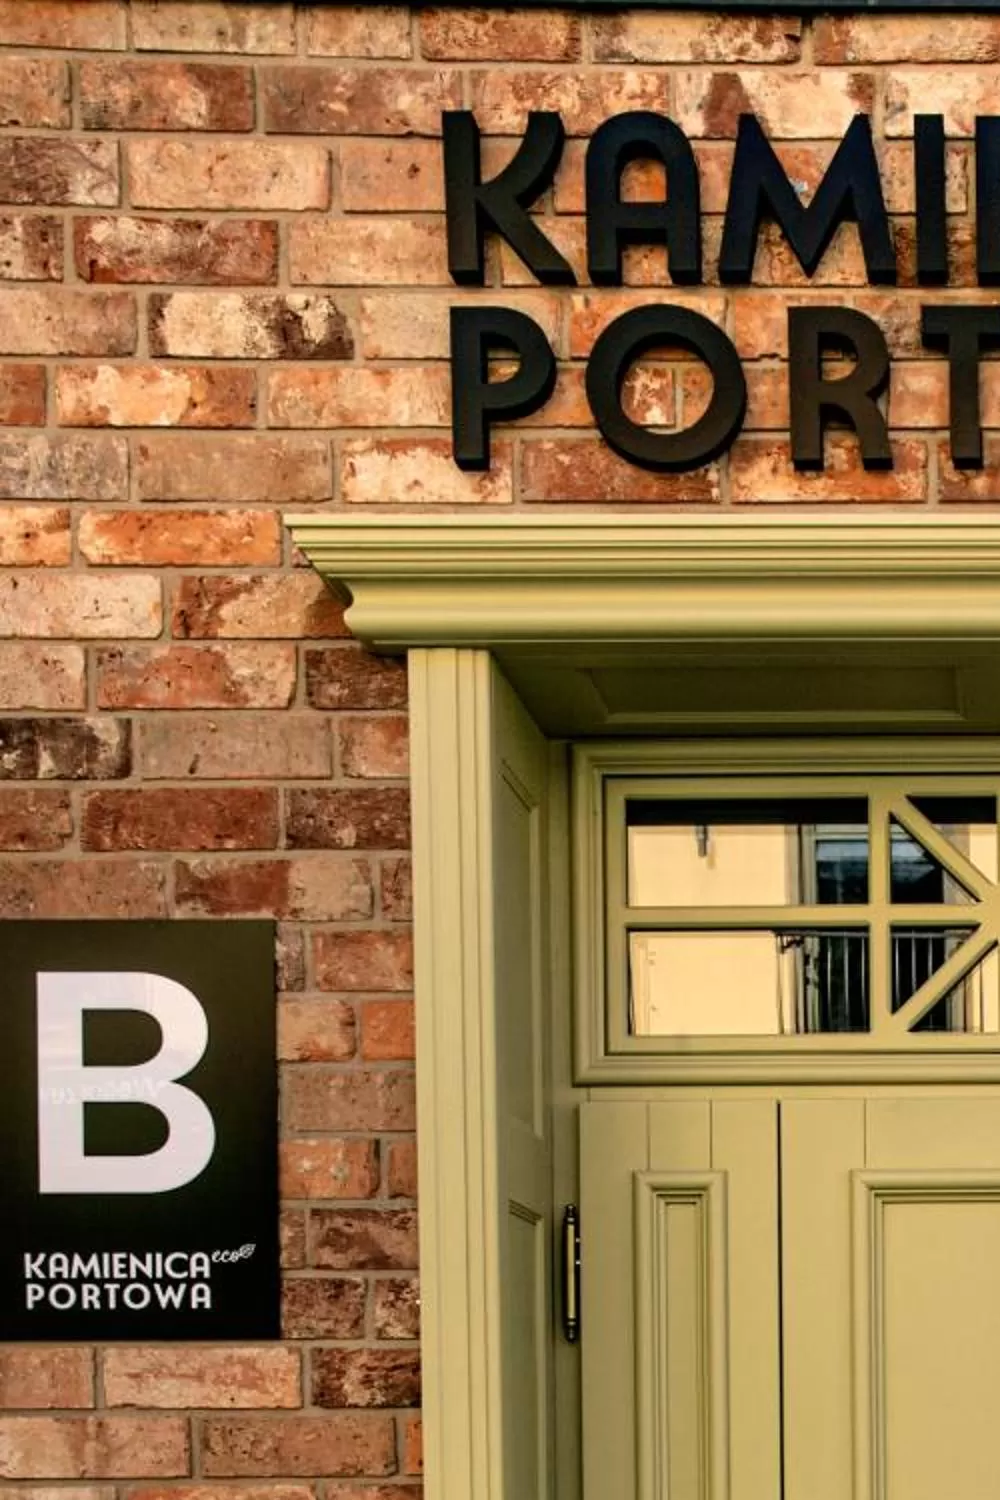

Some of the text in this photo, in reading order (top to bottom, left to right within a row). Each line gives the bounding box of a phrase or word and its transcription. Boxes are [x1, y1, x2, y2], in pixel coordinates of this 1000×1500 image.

[36, 971, 216, 1194] B
[23, 1252, 212, 1279] KAMIENICA
[26, 1282, 213, 1310] PORTOWA
